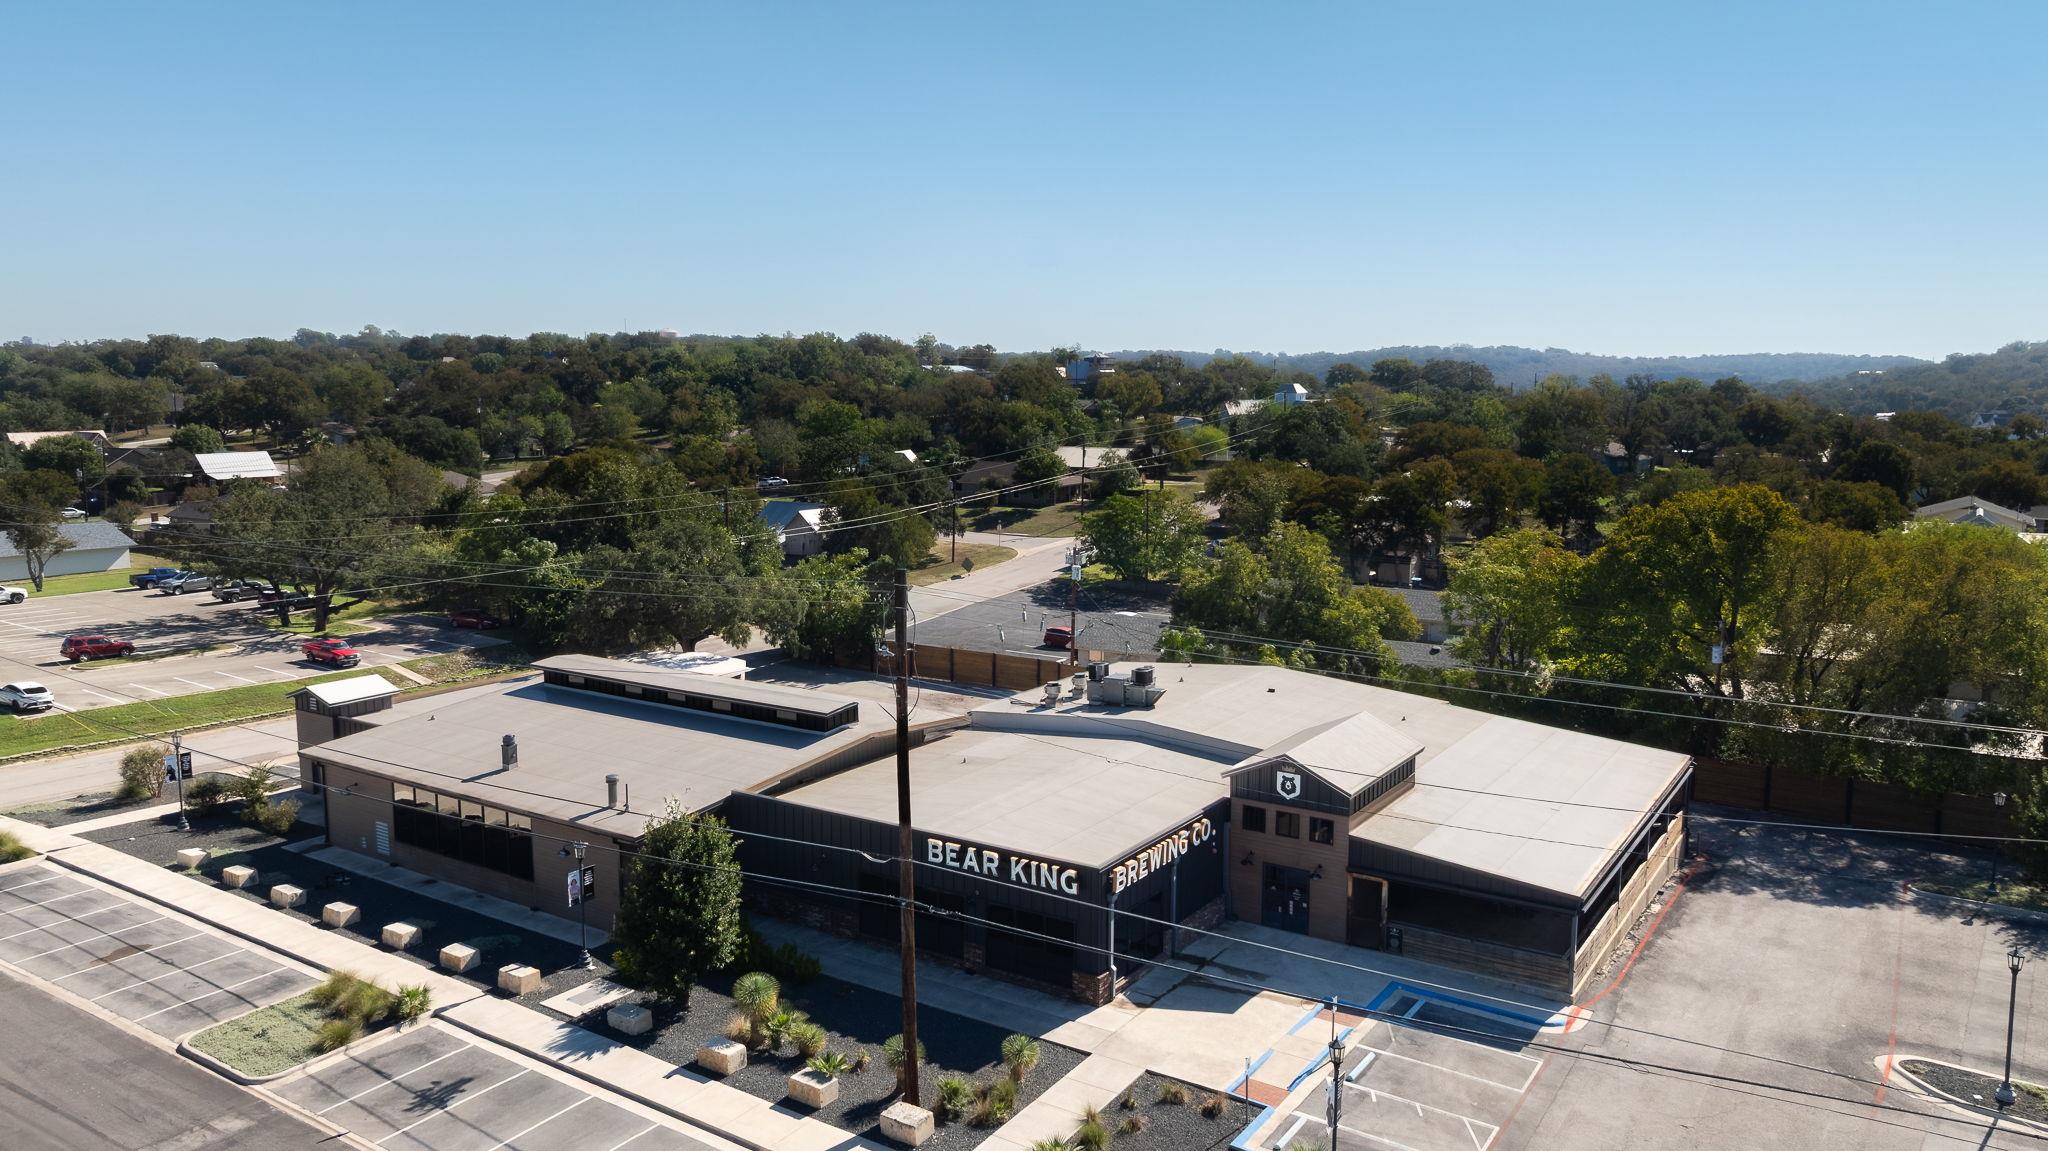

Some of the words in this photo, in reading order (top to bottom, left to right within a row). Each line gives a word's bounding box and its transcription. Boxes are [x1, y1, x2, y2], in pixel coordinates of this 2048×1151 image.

[927, 838, 999, 877] BEAR
[1010, 856, 1078, 895] KING
[1113, 830, 1188, 893] BREWING
[1192, 818, 1216, 847] CO.
